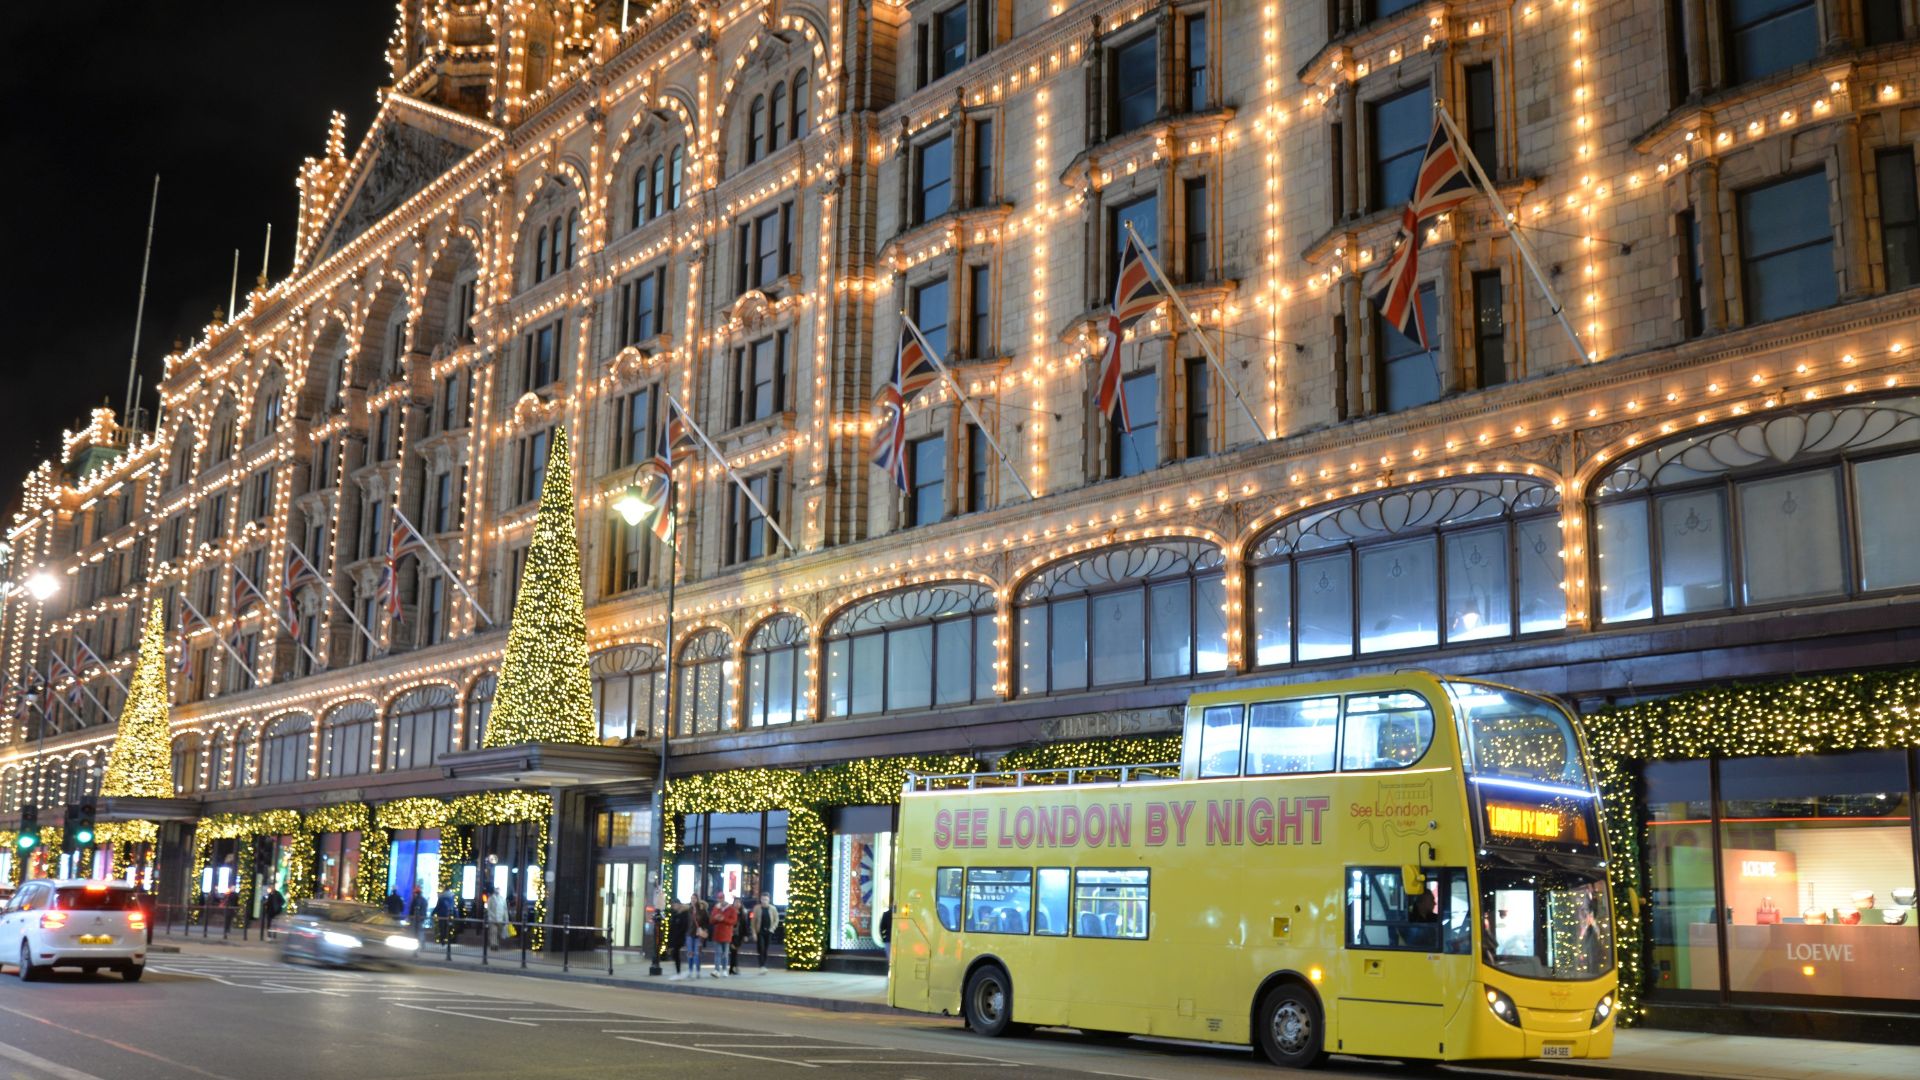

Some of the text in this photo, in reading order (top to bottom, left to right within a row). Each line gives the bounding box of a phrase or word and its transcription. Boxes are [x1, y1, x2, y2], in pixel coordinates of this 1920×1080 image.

[1350, 800, 1429, 817] See London
[934, 796, 1330, 849] SEE LONDON BY NIGHT
[1743, 861, 1777, 877] LOEWE
[1786, 943, 1855, 962] LOEWE
